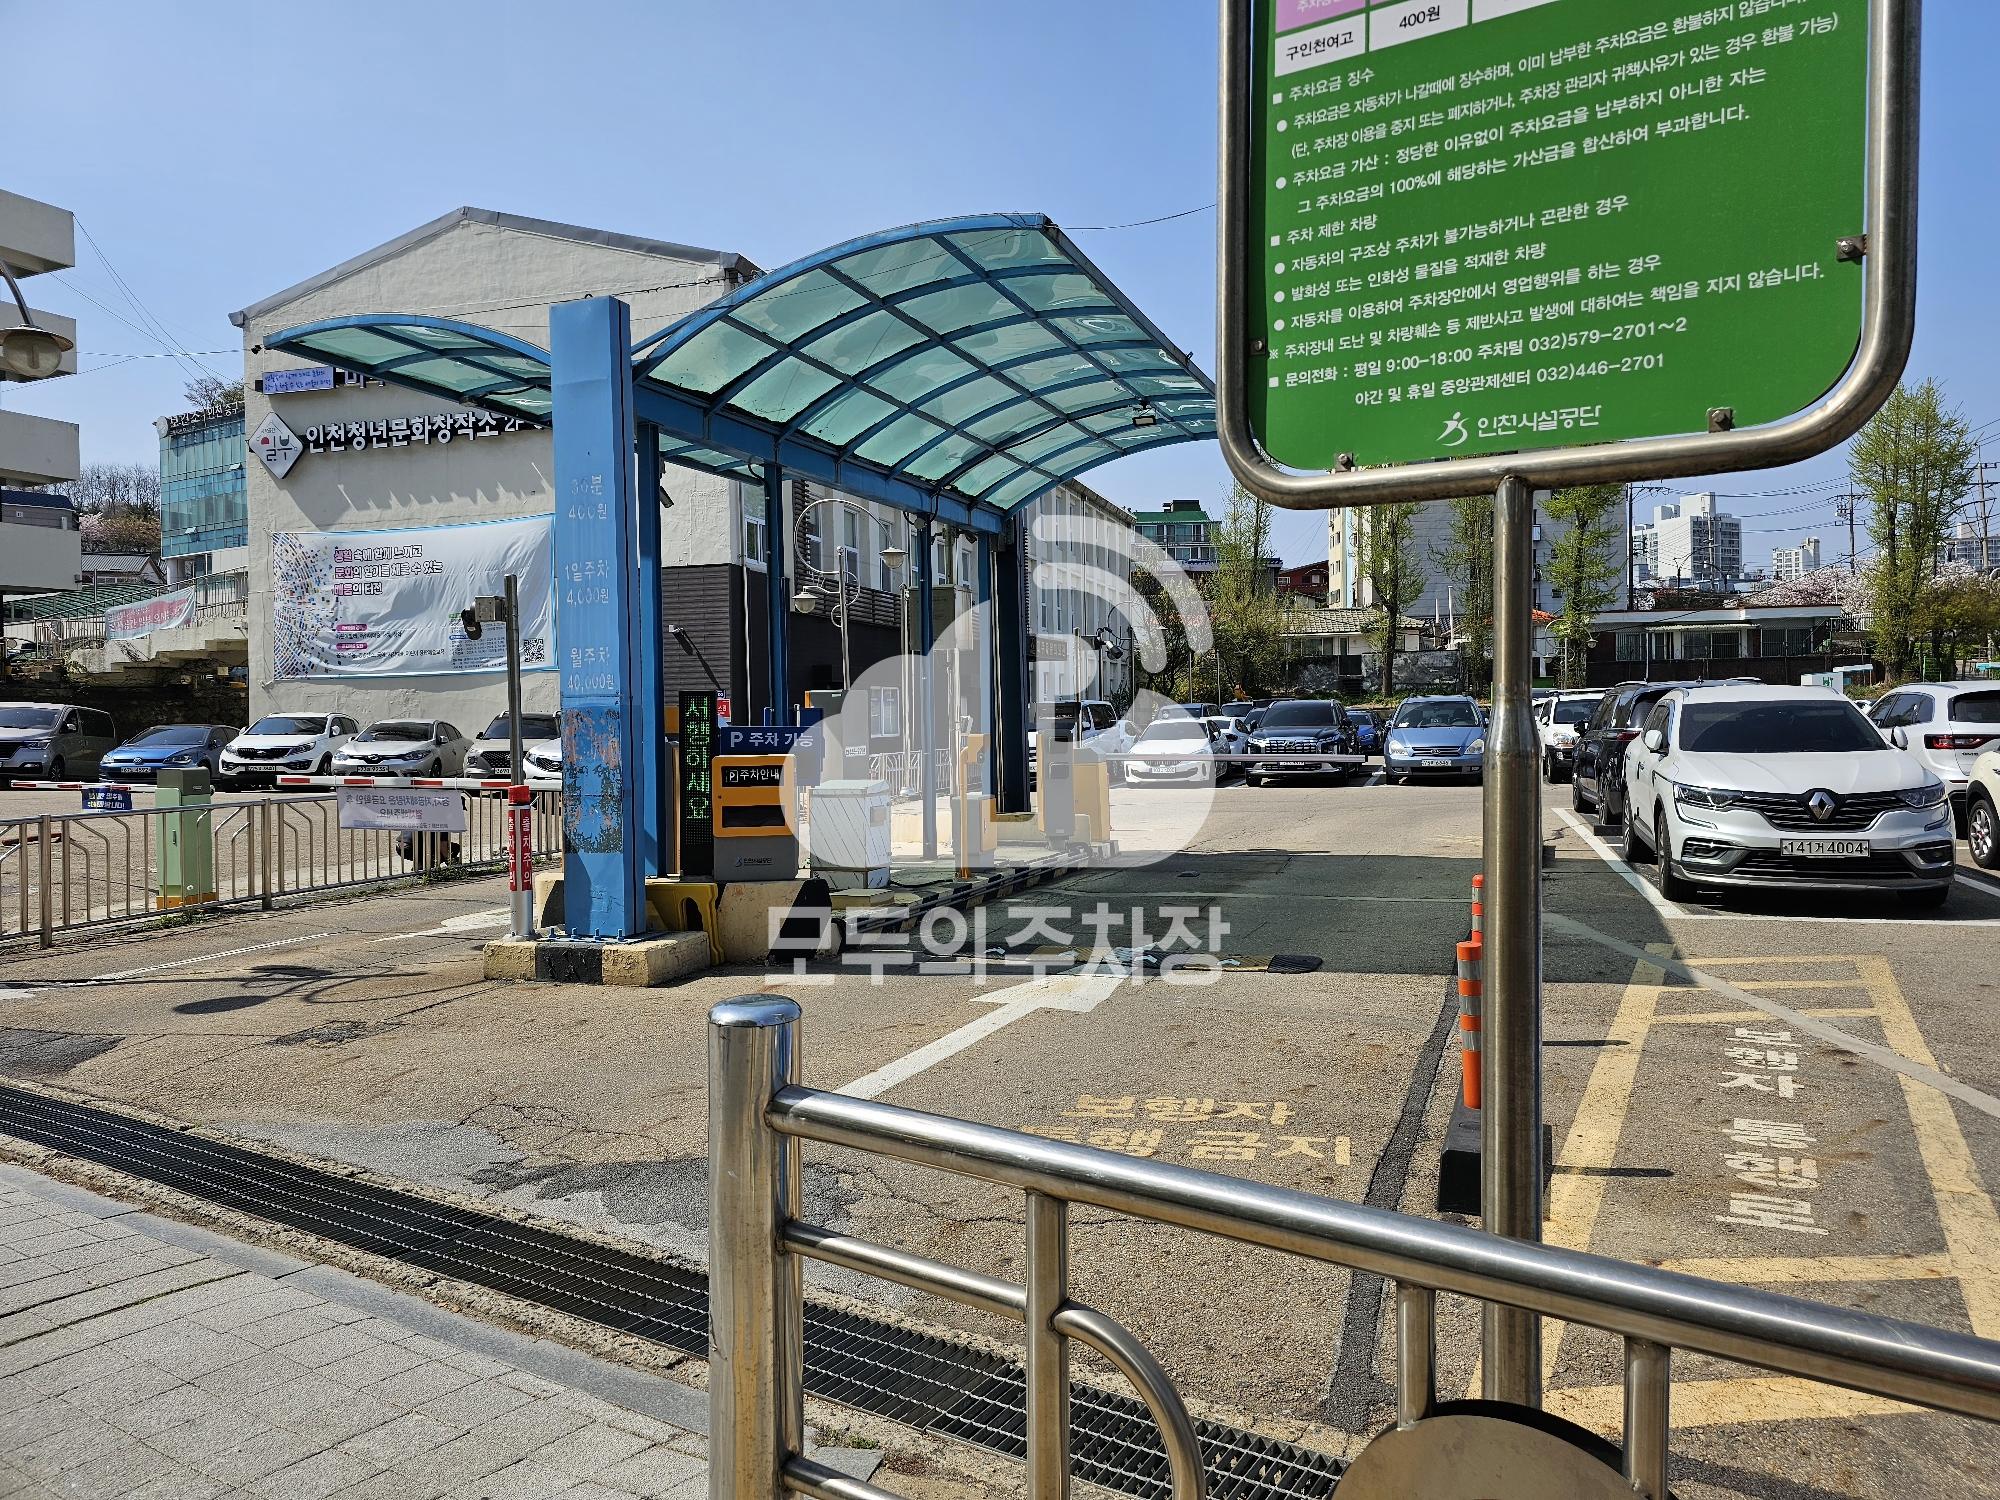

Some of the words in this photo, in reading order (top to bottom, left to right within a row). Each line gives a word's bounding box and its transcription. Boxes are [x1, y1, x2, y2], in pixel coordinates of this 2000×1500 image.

[1286, 31, 1353, 61] 구인천여고
[1399, 5, 1441, 29] 400원
[1289, 76, 1341, 101] 주차요금
[1347, 67, 1375, 87] 징수
[1294, 103, 1350, 129] 주차요금은
[1354, 91, 1401, 114] 자동차가
[1406, 77, 1455, 100] 나갈때에
[1459, 62, 1514, 89] 징수하며,
[1518, 53, 1545, 73] 이미
[1550, 42, 1591, 66] 납부한
[1595, 21, 1668, 52] 주차요금은
[1672, 5, 1733, 35] 환불하지
[1313, 132, 1348, 154] 주차장
[1352, 123, 1387, 144] 이용을
[1391, 114, 1415, 134] 중지
[1419, 108, 1443, 127] 또는
[1447, 93, 1515, 121] 폐지하거나,
[1520, 82, 1560, 105] 주차장
[1564, 69, 1608, 93] 관리자
[1612, 51, 1685, 82] 귀책사유가
[1690, 43, 1720, 64] 있는
[1725, 33, 1756, 55] 경우
[1761, 24, 1793, 47] 환불
[1799, 12, 1839, 36] 가능)
[1292, 162, 1345, 187] 주차요금
[1351, 154, 1379, 173] 가산
[1395, 141, 1438, 164] 정당한
[1445, 126, 1503, 151] 이유없이
[1508, 106, 1589, 139] 주차요금을
[1595, 89, 1663, 119] 납부하지
[1669, 75, 1723, 100] 아니한
[1729, 67, 1767, 86] 자는
[1297, 201, 1311, 214] 그
[1315, 182, 1384, 210] 주차요금의
[1390, 171, 1441, 195] 100%에
[1447, 156, 1508, 183] 해당하는
[1513, 140, 1576, 168] 가산금을
[1582, 125, 1649, 154] 합산하여
[1655, 104, 1750, 137] 부과합니다.
[1286, 229, 1313, 245] 주차
[1317, 221, 1345, 239] 제한
[1350, 213, 1378, 233] 차량
[1291, 249, 1344, 273] 자동차의
[1348, 240, 1391, 262] 구조상
[1396, 231, 1439, 253] 주차가
[1443, 213, 1535, 245] 불가능하거나
[1541, 202, 1589, 226] 곤란한
[1595, 194, 1629, 216] 경우
[1291, 280, 1331, 301] 발화성
[1336, 275, 1363, 292] 또는
[1367, 266, 1410, 287] 인화성
[1414, 258, 1458, 280] 물질을
[1464, 249, 1509, 271] 적재한
[1515, 241, 1547, 262] 차량
[1291, 307, 1343, 330] 자동차를
[1348, 297, 1403, 321] 이용하여
[1408, 281, 1496, 311] 주차장안에서
[1503, 268, 1581, 296] 영업행위를
[1587, 262, 1621, 280] 하는
[1627, 254, 1662, 275] 경우
[1285, 338, 1334, 360] 주차장내
[1338, 332, 1365, 350] 도난
[1370, 330, 1382, 346] 및
[1387, 319, 1442, 344] 차량훼손
[1447, 318, 1460, 334] 등
[1465, 306, 1524, 331] 제반사고
[1529, 301, 1574, 322] 발생에
[1581, 290, 1644, 313] 대하여는
[1650, 280, 1700, 301] 책임을
[1706, 273, 1741, 294] 지지
[1748, 261, 1825, 290] 않습니다.
[1285, 366, 1337, 387] 문의전화
[1353, 360, 1381, 378] 평일
[1477, 338, 1523, 360] 주차팀
[1355, 388, 1383, 407] 야간
[1388, 386, 1401, 402] 및
[1406, 381, 1435, 400] 휴일
[1440, 368, 1530, 397] 중앙관제센터
[1537, 353, 1664, 382] 032)446-2701
[170, 411, 200, 428] 보건소
[306, 411, 498, 453] 인천청년문화창작소
[1477, 405, 1601, 438] 인천시설공단
[570, 646, 610, 669] 월주차
[730, 732, 743, 748] P
[749, 732, 779, 747] 주차
[784, 732, 814, 747] 가능
[739, 769, 780, 780] 주차안내
[1788, 842, 1864, 853] 141거4004
[1059, 1094, 1296, 1125] 보행자
